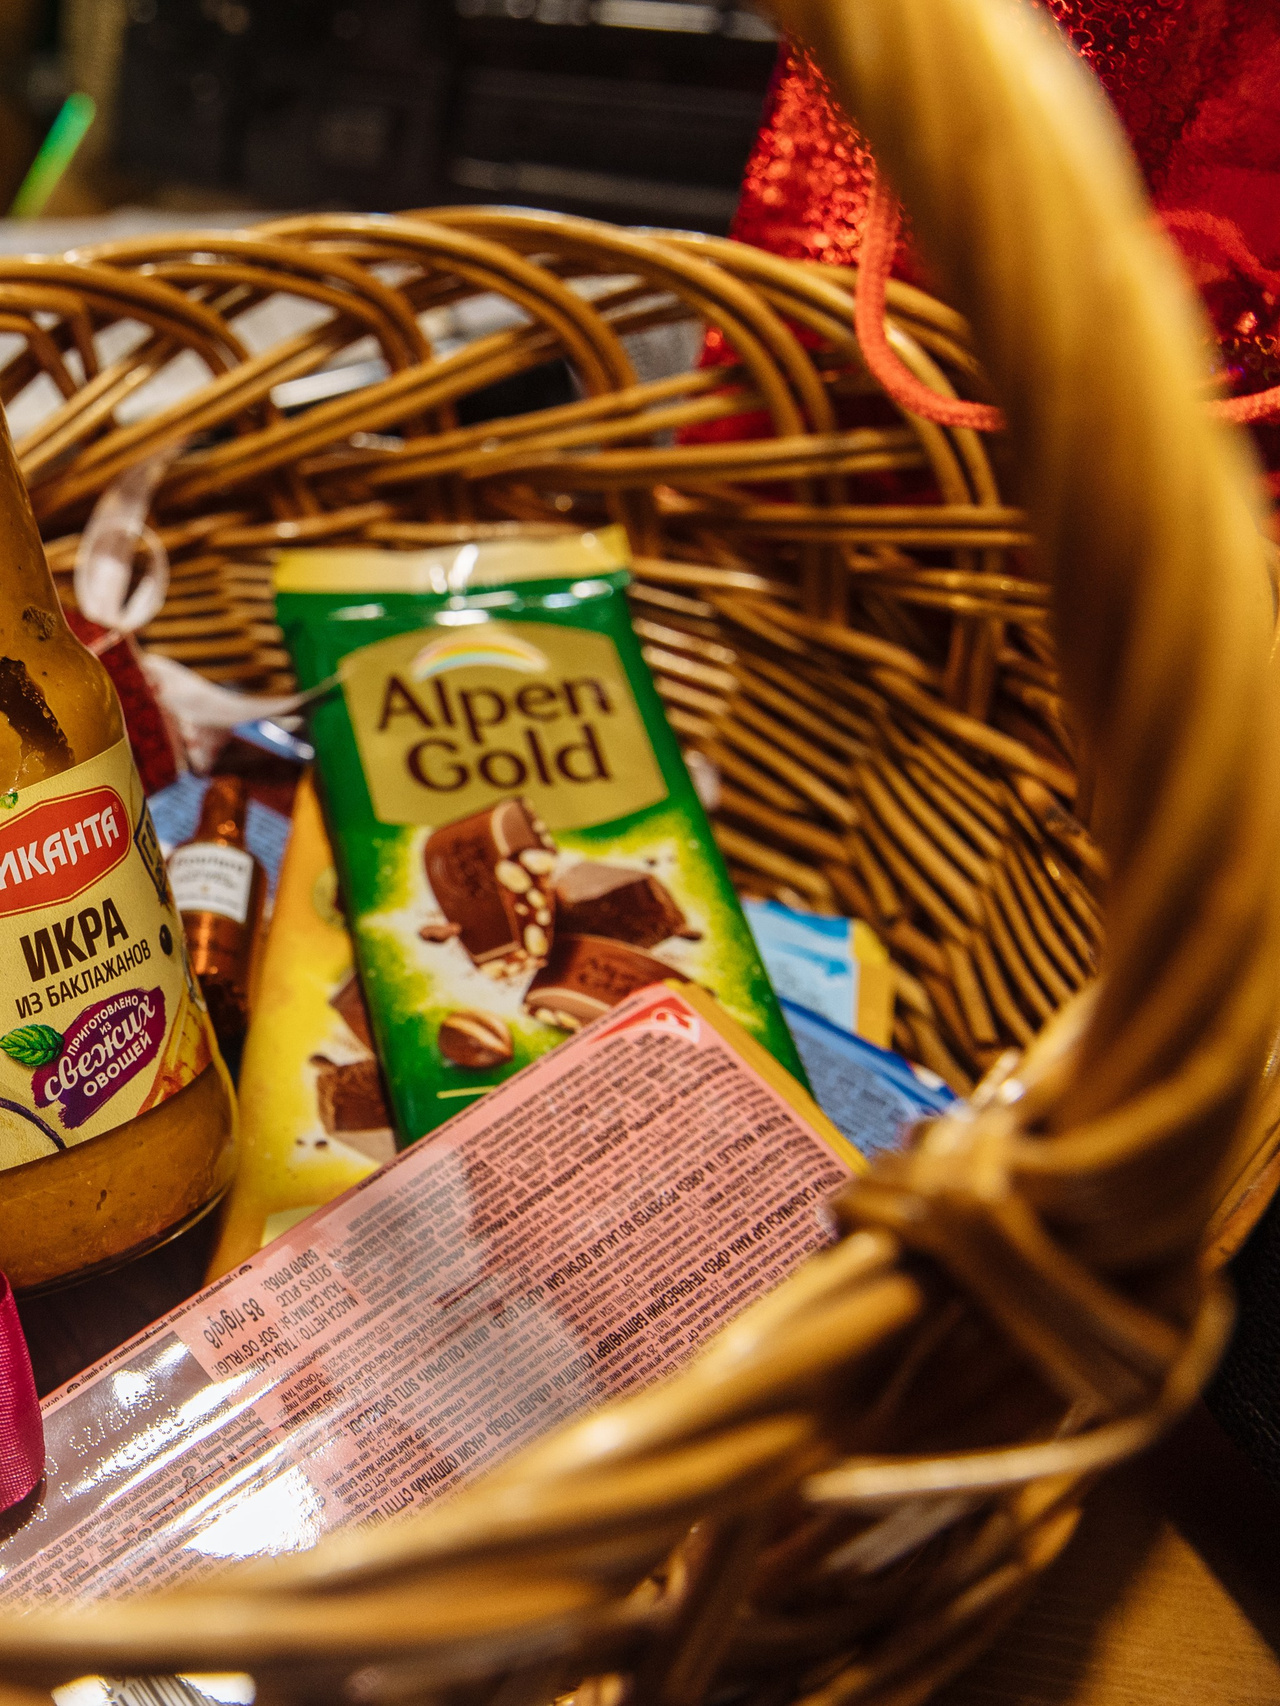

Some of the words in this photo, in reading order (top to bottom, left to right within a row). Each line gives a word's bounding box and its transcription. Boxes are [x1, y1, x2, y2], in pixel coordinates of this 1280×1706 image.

[376, 673, 616, 745] Alpen
[405, 722, 613, 793] Gold
[19, 897, 130, 983] ИКРА
[15, 992, 44, 1019] ИЗ
[45, 939, 152, 1008] БАКЛАЖАНОВ
[67, 995, 139, 1057] ПРИГОТОВЛЕНО
[99, 1021, 112, 1036] ИЗ
[44, 995, 156, 1102] свежих
[83, 1030, 153, 1097] ОВОЩЕЙ
[674, 1166, 707, 1196] «OREO»
[630, 1186, 680, 1229] PECHENYESI
[727, 1232, 755, 1258] ЖАНА
[749, 1220, 771, 1242] БАР
[699, 1248, 734, 1279] «ОРЕО»
[318, 1277, 346, 1303] ТАЗА
[513, 1283, 548, 1314] «ALPEN
[641, 1267, 707, 1322] ПЕЧЕНЬЕСИНИН
[239, 1295, 266, 1323] 85
[323, 1291, 359, 1324] МАССА
[487, 1304, 520, 1333] GOLD»
[255, 1325, 279, 1347] SOF
[295, 1312, 330, 1343] НЕТТО:
[390, 1327, 420, 1352] BOSHQA
[459, 1323, 493, 1353] «MAYIN
[209, 1337, 260, 1380] OG'IRLIGI:
[269, 1334, 298, 1361] ТАЗА
[414, 1343, 465, 1386] QULUPNAY»
[548, 1351, 596, 1392] КОШУЛГАН
[391, 1376, 421, 1403] SUTLI
[512, 1381, 556, 1419] «АЛЬПЕН
[277, 1407, 309, 1434] MUMKIN.
[343, 1392, 398, 1438] SHOKOLADI.
[482, 1405, 521, 1441] ГОЛЬД»
[411, 1423, 430, 1440] ЖЕР
[452, 1429, 490, 1464] «НАЗИК
[354, 1462, 377, 1483] ЖАНА
[407, 1452, 462, 1499] КУЛПУНАЙ»
